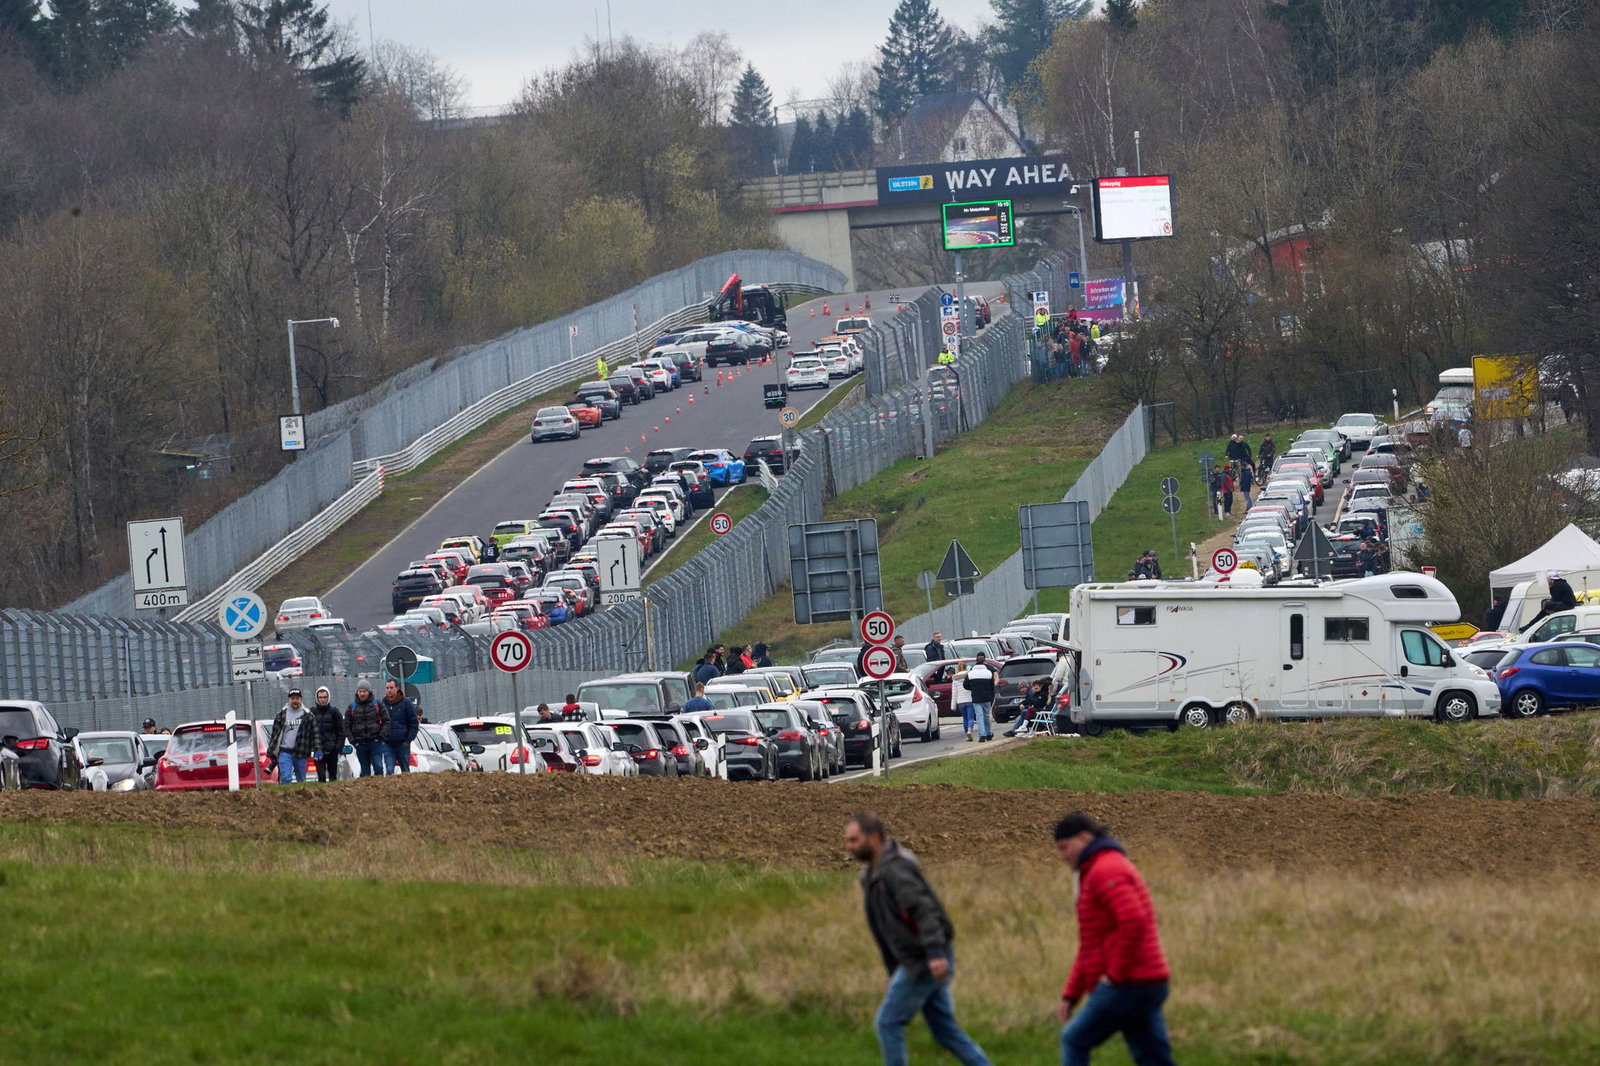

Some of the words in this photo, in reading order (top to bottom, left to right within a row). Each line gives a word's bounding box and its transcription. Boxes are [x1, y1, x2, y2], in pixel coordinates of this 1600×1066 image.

[945, 167, 997, 190] WAY
[1005, 163, 1075, 186] AHEA
[285, 417, 299, 429] 21
[783, 412, 795, 422] 30
[714, 519, 728, 530] 50
[1217, 554, 1233, 568] 50
[869, 620, 888, 636] 50
[500, 642, 524, 662] 70
